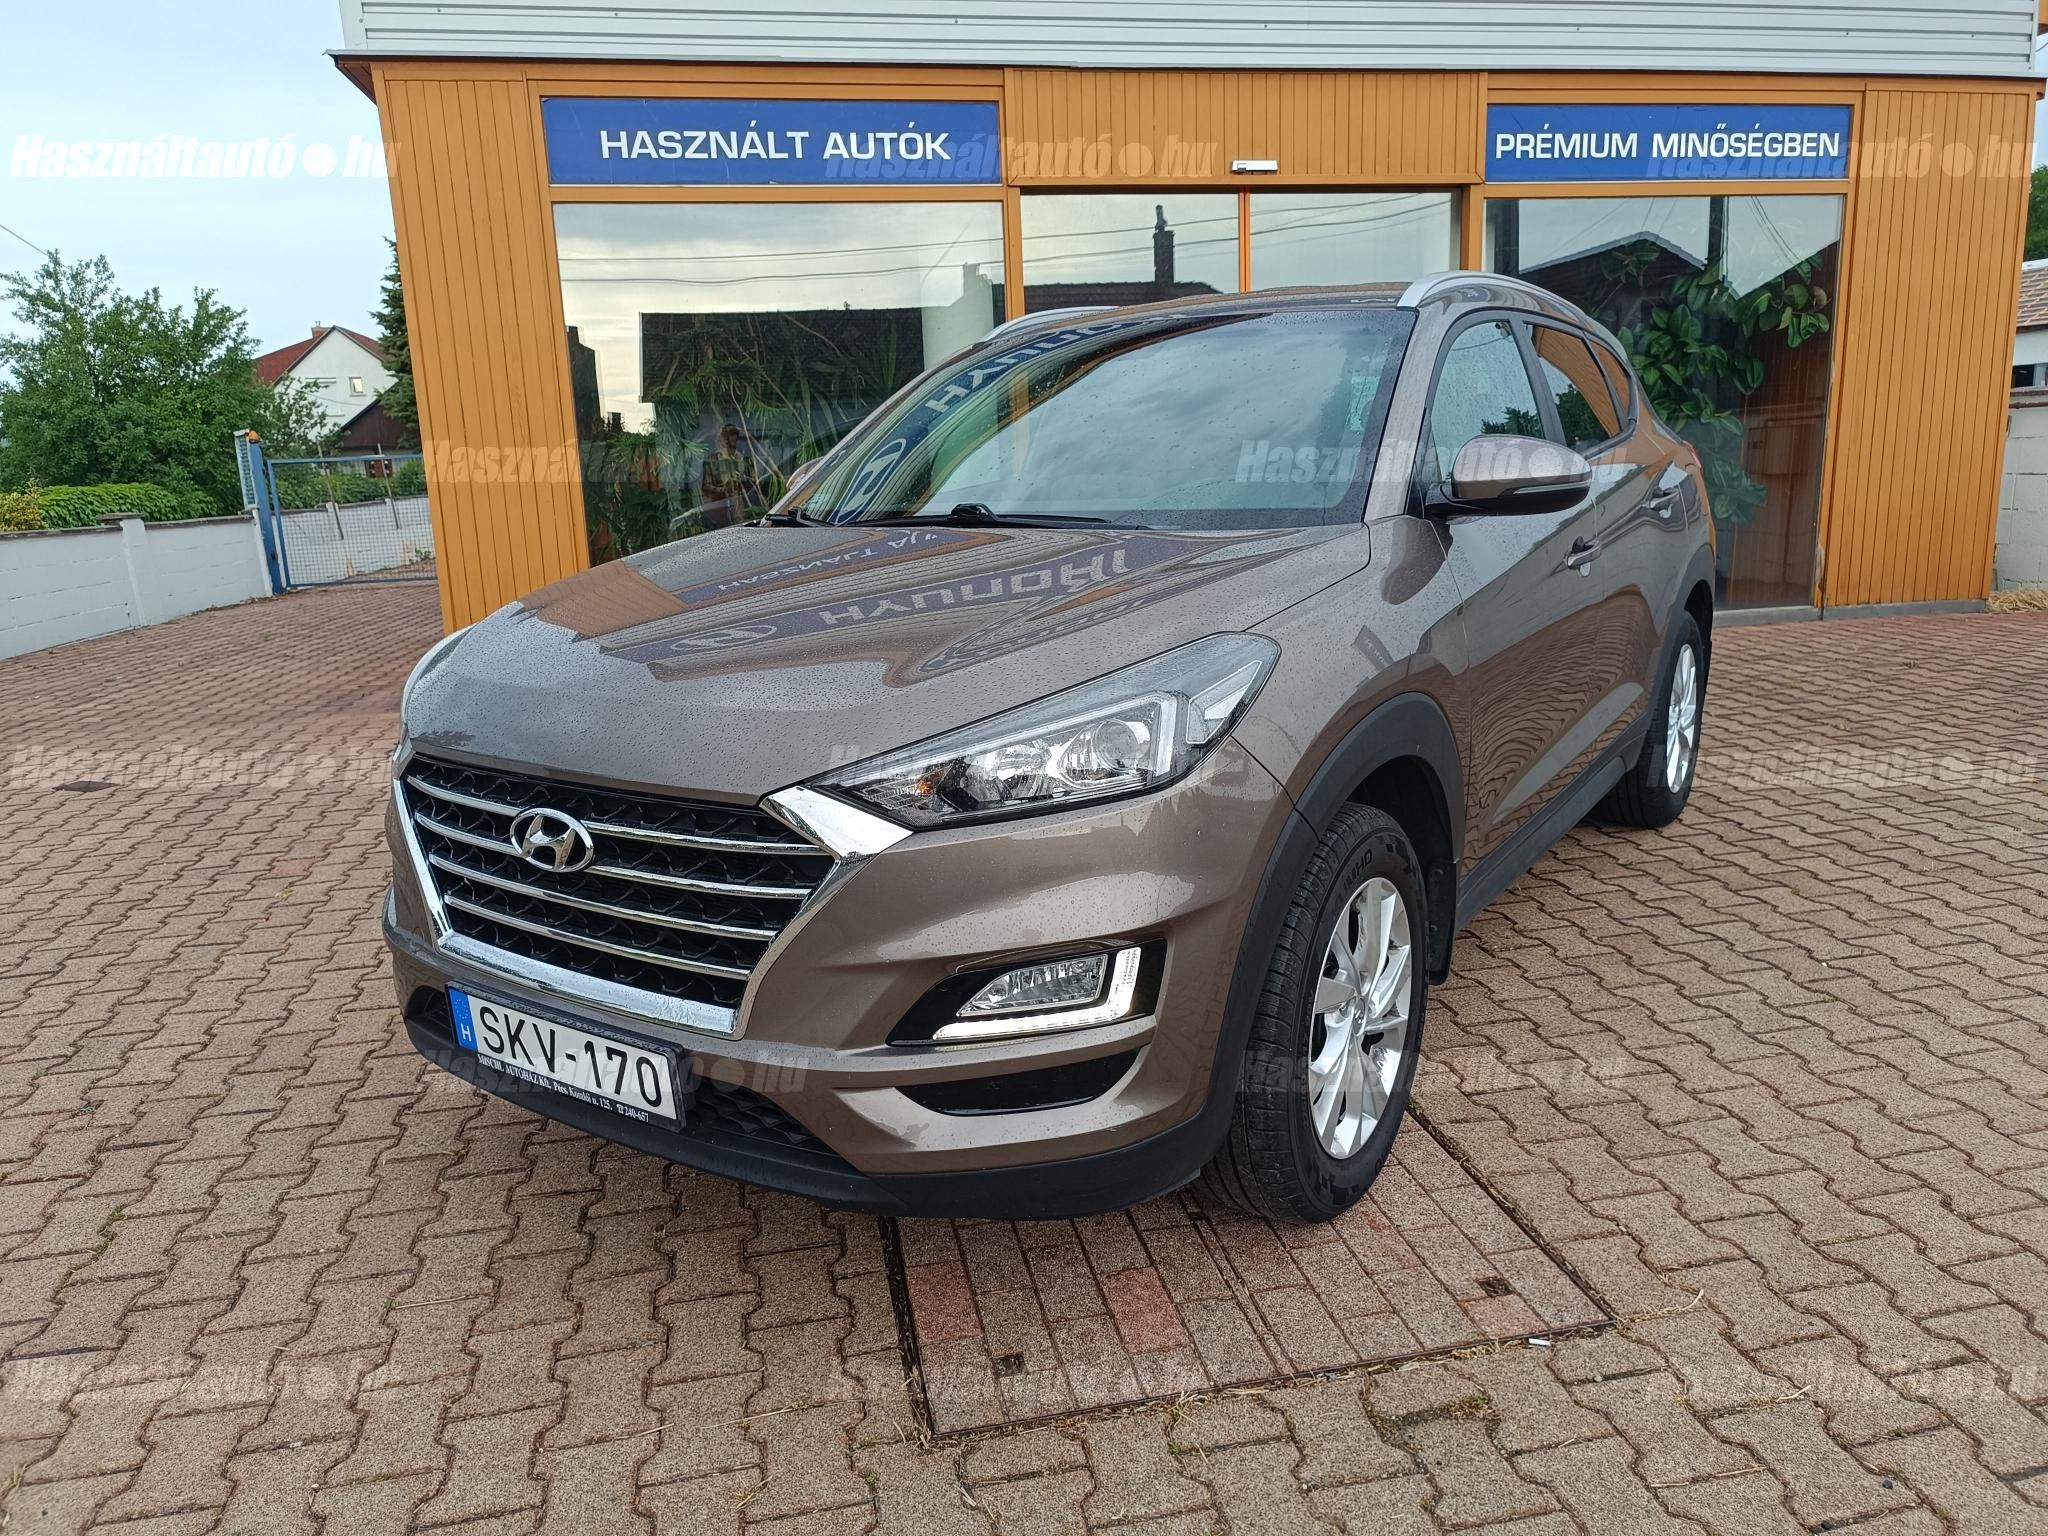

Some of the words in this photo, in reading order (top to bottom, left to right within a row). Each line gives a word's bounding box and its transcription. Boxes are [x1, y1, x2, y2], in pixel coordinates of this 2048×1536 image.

[600, 120, 809, 160] HASZNÁLT
[823, 121, 951, 161] AUTÓK
[1495, 123, 1639, 159] PRÉMIUM
[1652, 122, 1840, 158] MINŐSÉGBEN
[461, 1024, 471, 1042] H
[479, 1006, 662, 1107] SKV-170
